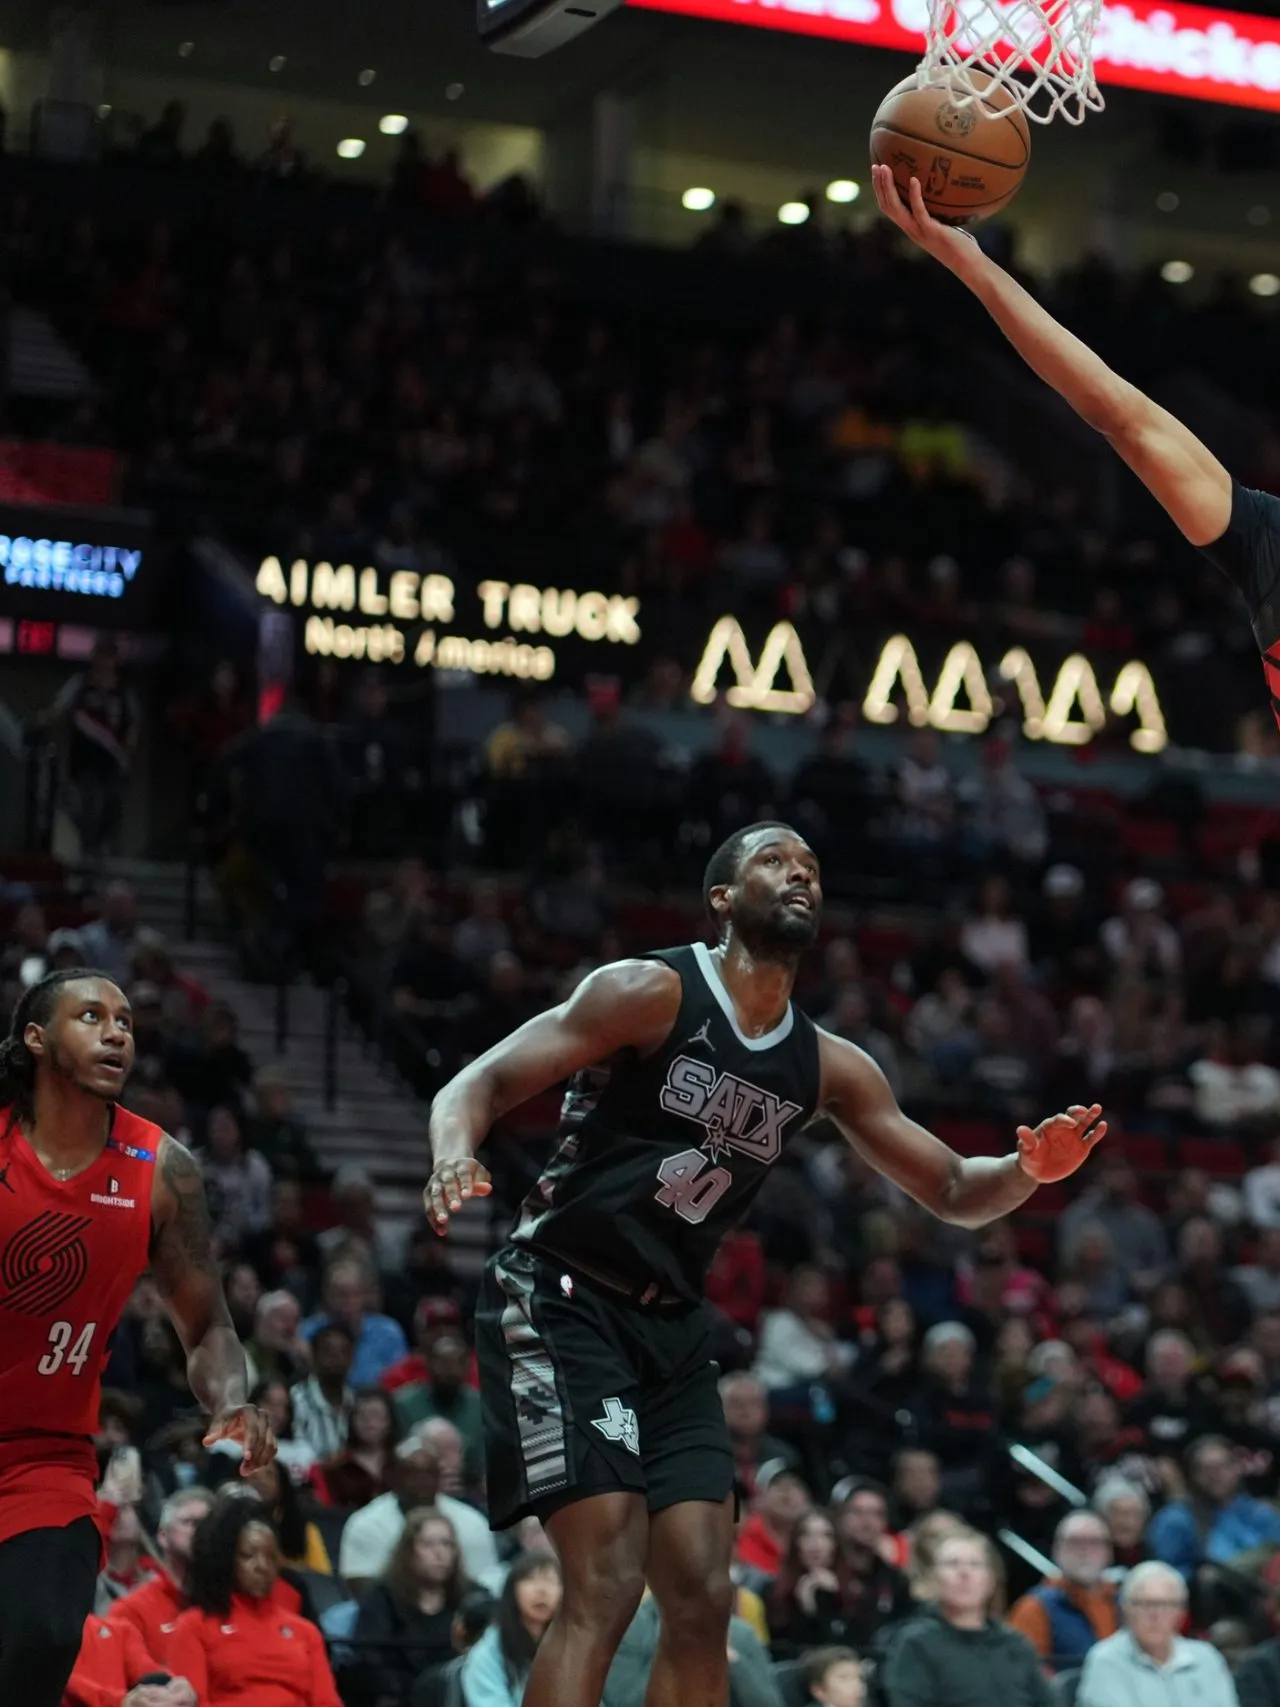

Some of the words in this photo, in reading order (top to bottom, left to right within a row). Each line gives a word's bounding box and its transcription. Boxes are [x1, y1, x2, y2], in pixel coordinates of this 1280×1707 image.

[477, 579, 642, 645] TRUCK
[659, 1053, 804, 1165] SATX
[654, 1148, 732, 1224] 40
[37, 1320, 97, 1376] 34
